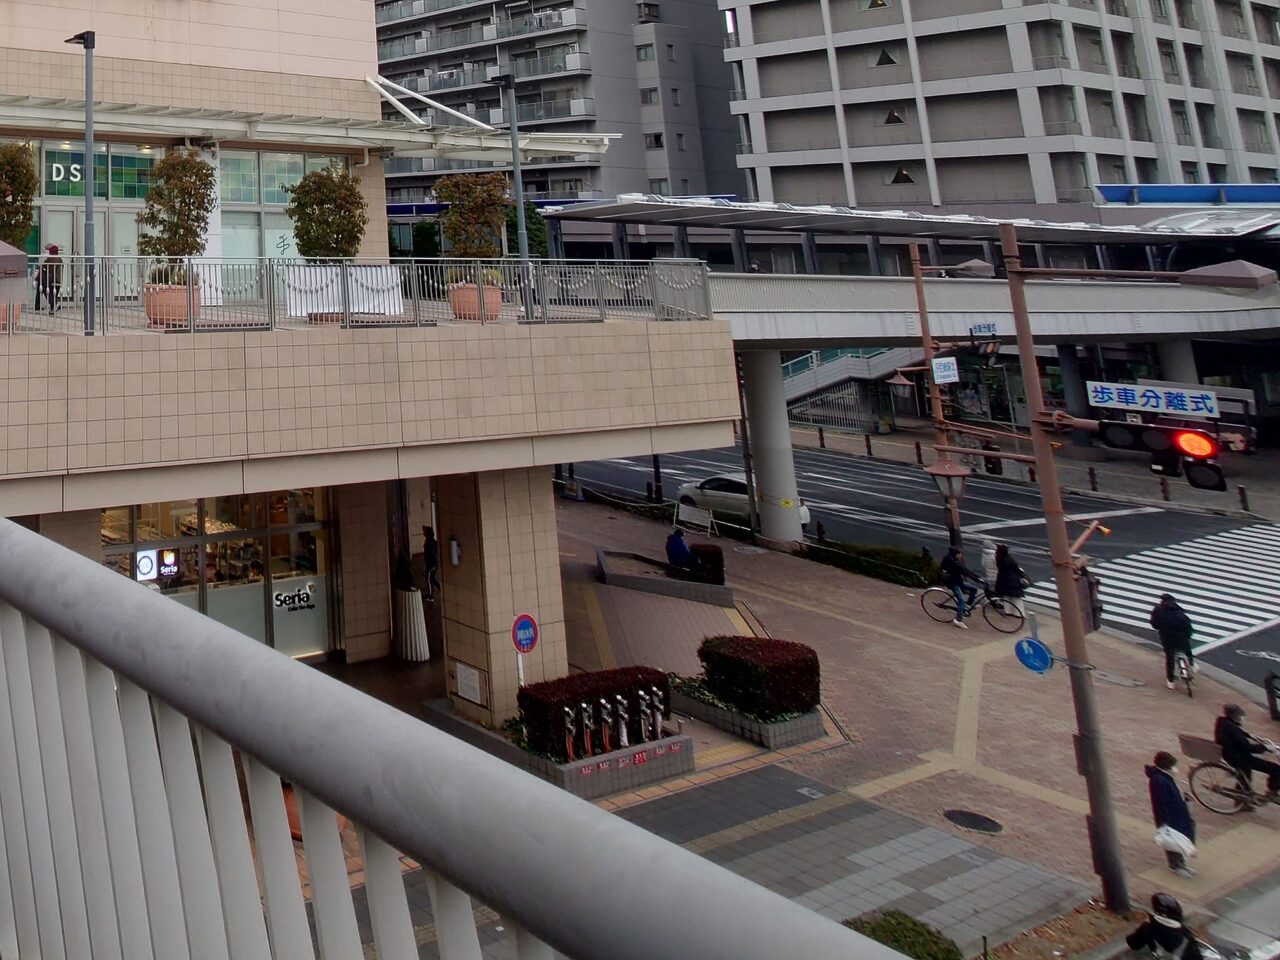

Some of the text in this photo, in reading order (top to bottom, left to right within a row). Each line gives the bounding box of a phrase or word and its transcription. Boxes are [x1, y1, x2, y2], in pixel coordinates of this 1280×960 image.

[1091, 384, 1215, 414] 歩車分離式
[275, 588, 310, 608] Seria
